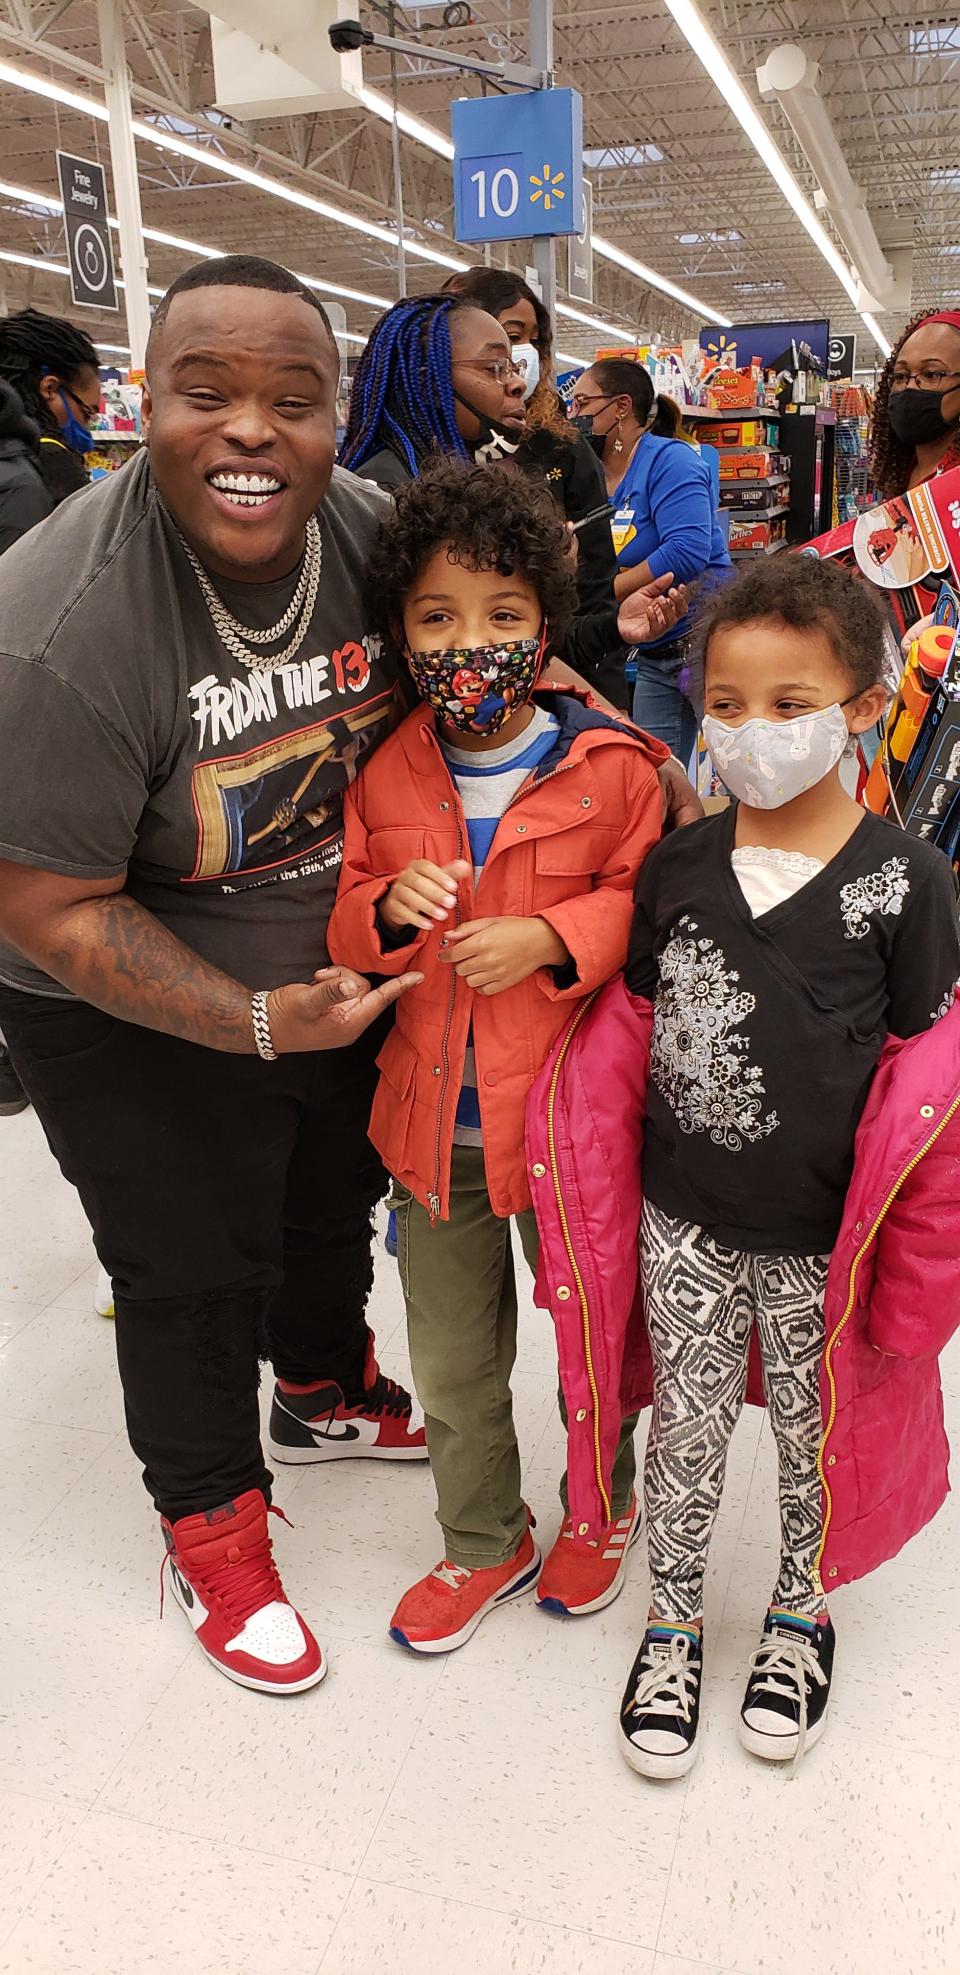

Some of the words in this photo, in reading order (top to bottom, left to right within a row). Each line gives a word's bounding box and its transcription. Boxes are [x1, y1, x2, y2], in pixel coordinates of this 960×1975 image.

[74, 169, 91, 187] Fine
[71, 186, 98, 209] Jewelry
[470, 168, 519, 217] 10
[558, 376, 577, 396] rbit
[921, 512, 933, 534] WATER
[928, 534, 943, 565] WORKING
[187, 669, 278, 752] FRIDAY
[274, 654, 332, 710] THE
[280, 867, 298, 881] the
[299, 863, 324, 876] 13th,
